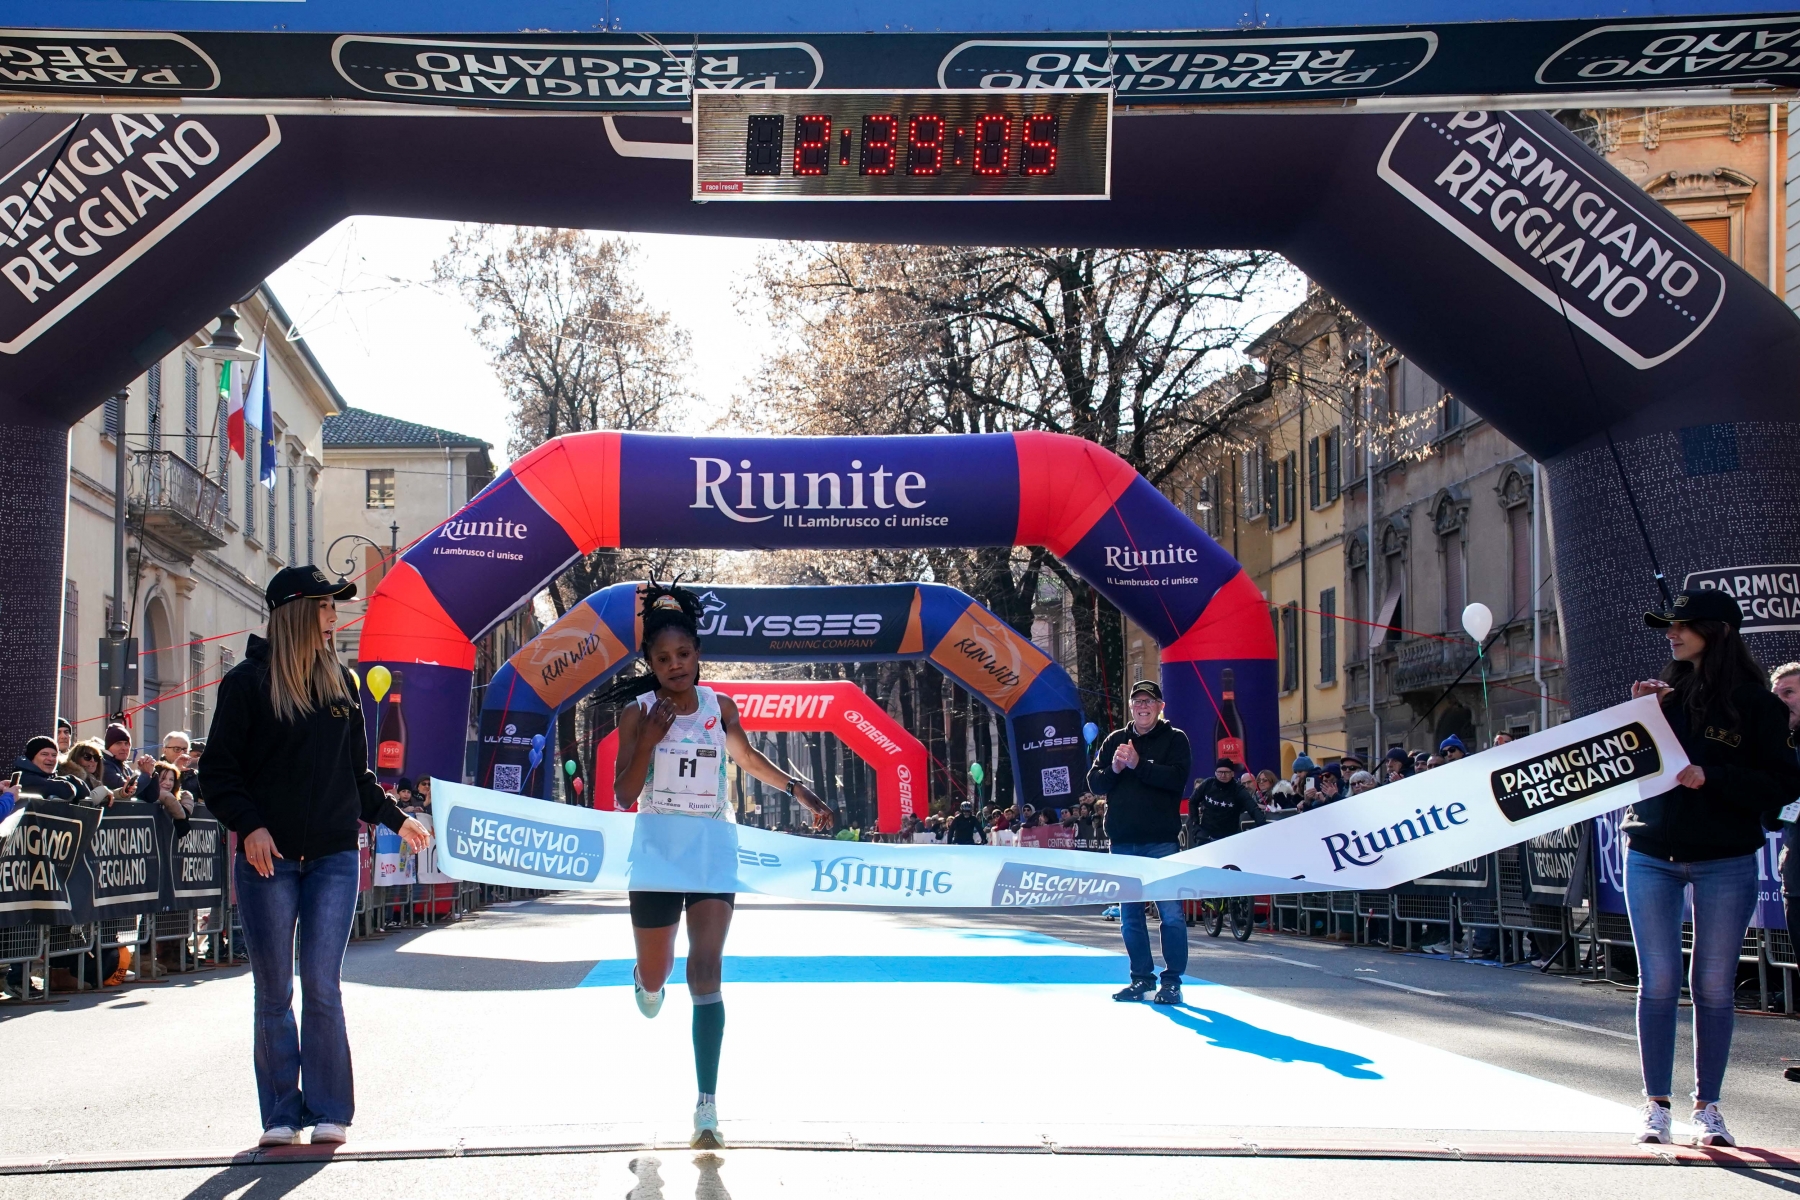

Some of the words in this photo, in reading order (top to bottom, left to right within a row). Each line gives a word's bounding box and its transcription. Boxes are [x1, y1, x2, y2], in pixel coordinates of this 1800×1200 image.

[1025, 49, 1356, 73] REGGIANO
[794, 115, 1057, 175] 2:39:05
[0, 120, 220, 304] REGGIANO
[1434, 149, 1648, 318] REGGIANO
[689, 457, 927, 523] Riunite
[438, 517, 528, 541] Riunite
[783, 515, 793, 528] Il
[799, 514, 880, 528] Lambrusco
[884, 514, 897, 527] ci
[901, 514, 949, 527] unisce
[440, 547, 485, 557] Lambrusco
[487, 549, 495, 558] ci
[496, 552, 524, 561] unisce
[1103, 543, 1198, 572] Riunite
[1114, 577, 1159, 586] Lambrusco
[1161, 577, 1169, 586] ci
[1171, 576, 1199, 585] unisce
[697, 613, 883, 637] ULYSSES
[769, 640, 821, 650] RUNNING
[822, 639, 877, 650] COMPANY
[954, 638, 993, 663] RUN
[541, 652, 569, 685] RUN
[733, 694, 835, 719] ENERVIT
[484, 735, 534, 746] ULYSSE
[856, 719, 902, 755] ENERVIT
[1022, 736, 1079, 751] ULYSSES
[678, 757, 697, 778] F1
[1500, 729, 1640, 794] PARMIGIANO
[1521, 755, 1636, 810] REGGIANO
[899, 781, 914, 820] ENER
[1321, 801, 1469, 873] Riunite
